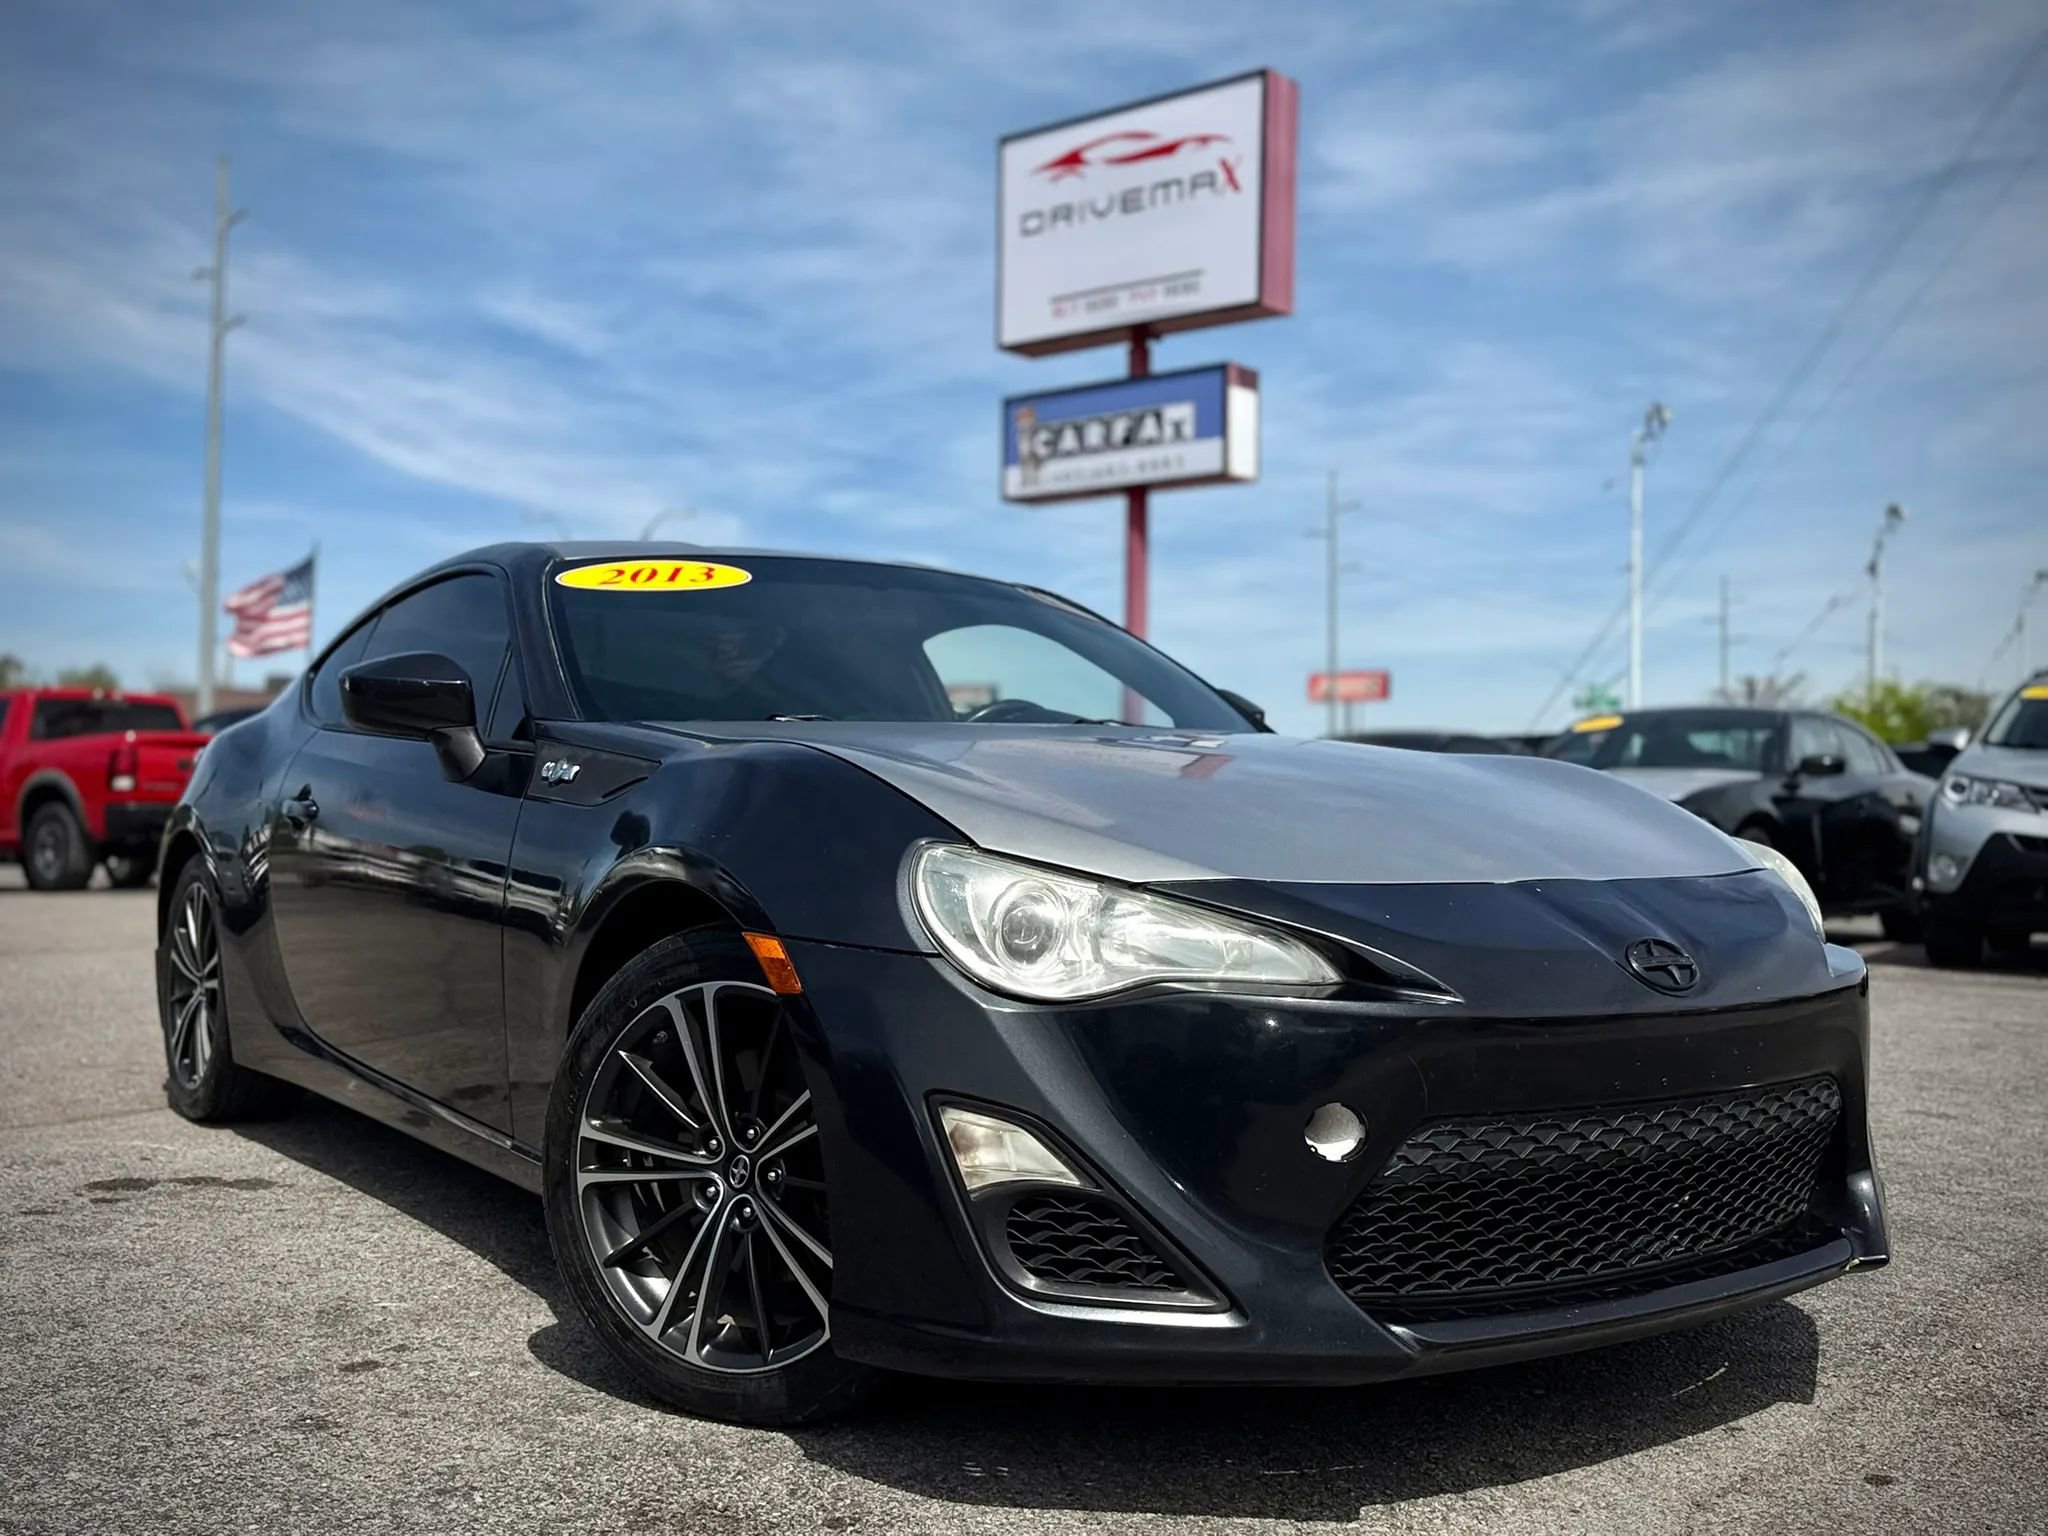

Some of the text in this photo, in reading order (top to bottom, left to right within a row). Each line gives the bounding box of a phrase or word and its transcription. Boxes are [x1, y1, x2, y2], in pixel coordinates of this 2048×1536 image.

[1019, 157, 1242, 238] DRIVEMAX
[1032, 405, 1192, 458] CARFAX
[599, 566, 716, 585] 2013
